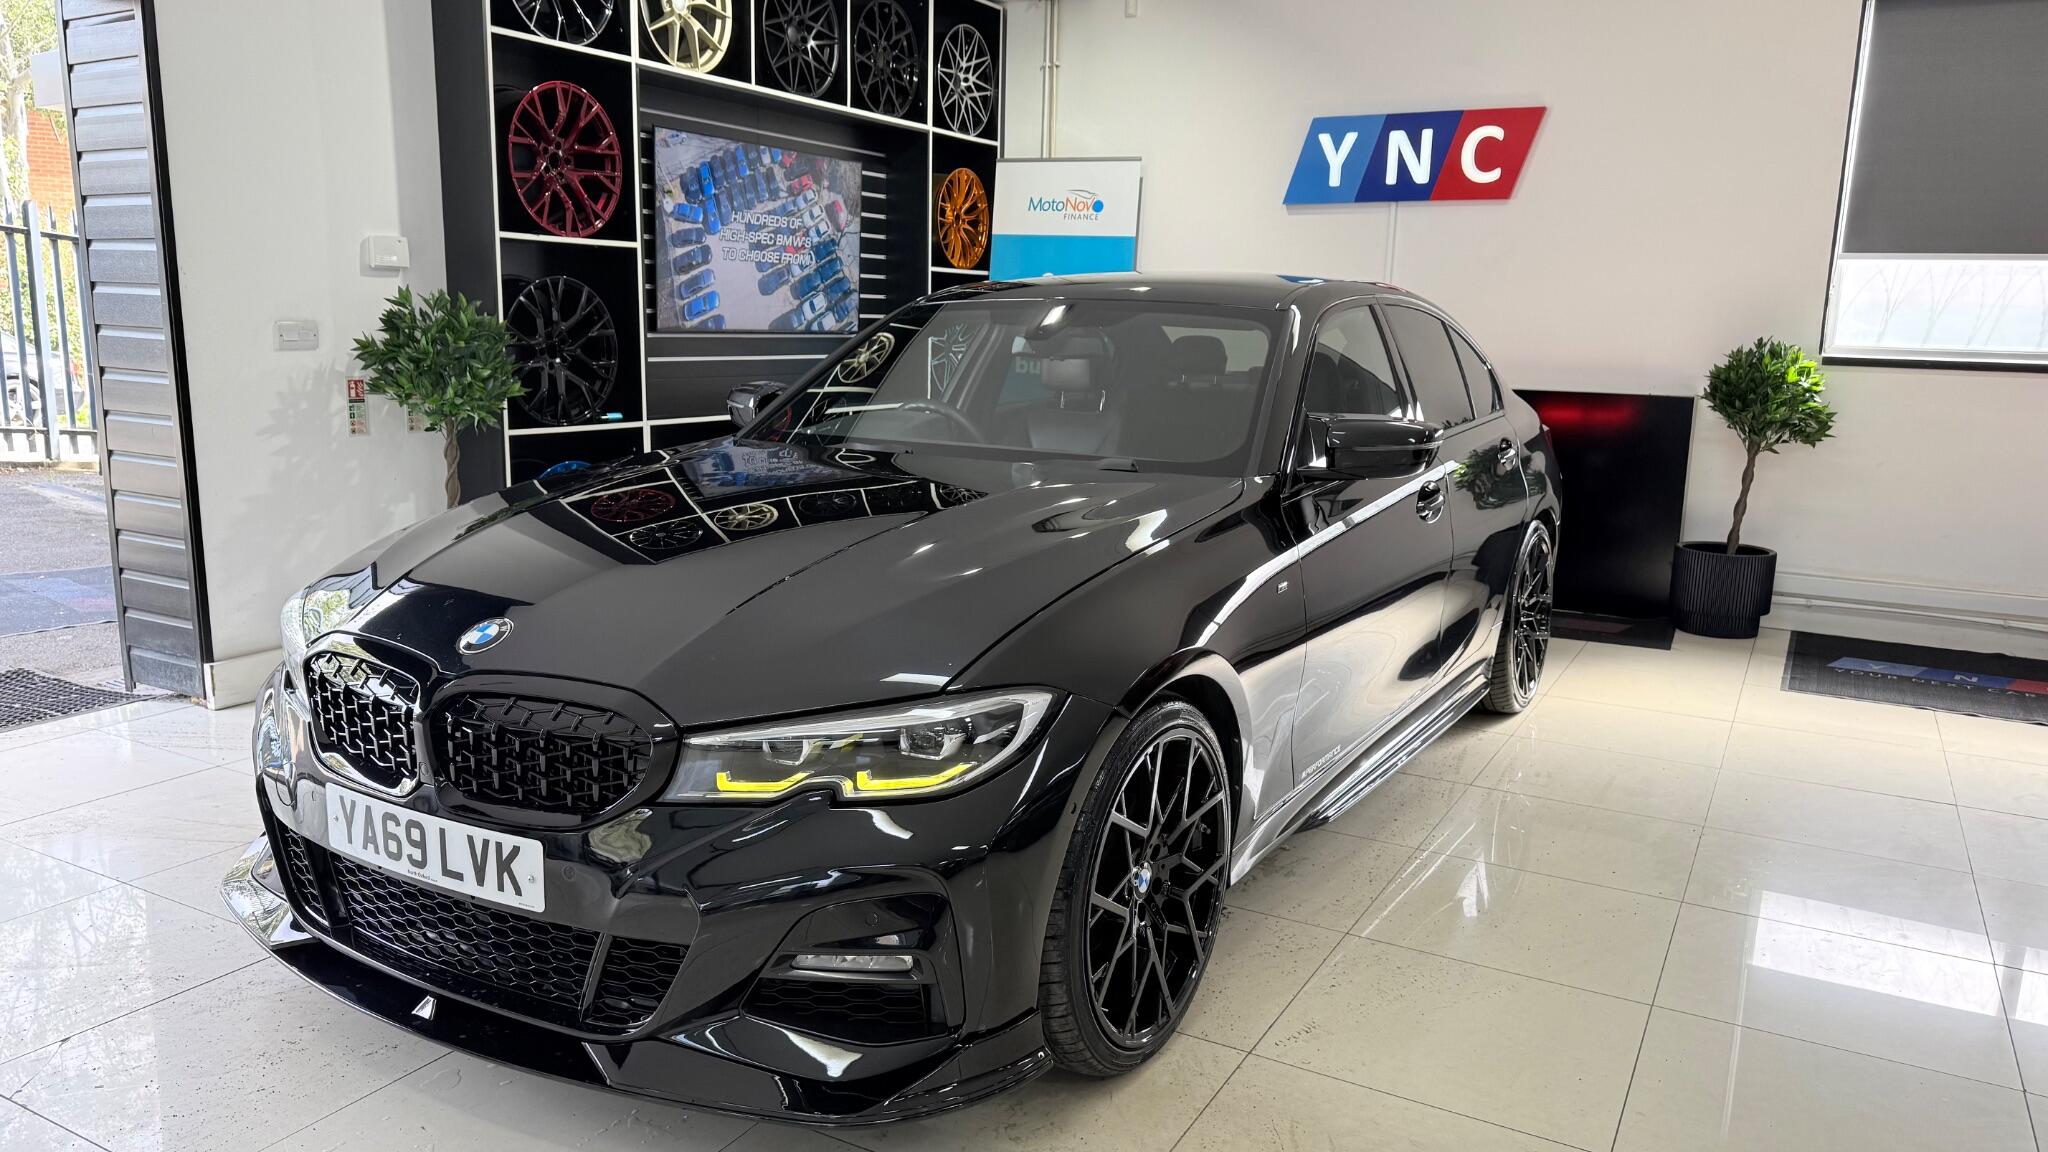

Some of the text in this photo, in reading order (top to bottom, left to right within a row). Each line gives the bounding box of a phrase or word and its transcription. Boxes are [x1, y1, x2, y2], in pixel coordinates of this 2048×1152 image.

[1318, 125, 1505, 187] YNC
[731, 211, 803, 229] HUNDREDS OF
[1063, 213, 1099, 221] FINANCE
[719, 229, 775, 244] HIGH-SPEC
[722, 247, 737, 260] TO
[739, 249, 780, 263] CHOOSE
[1834, 669, 2036, 697] YOUR NEXT CAR
[339, 795, 523, 897] YA69 LVK
